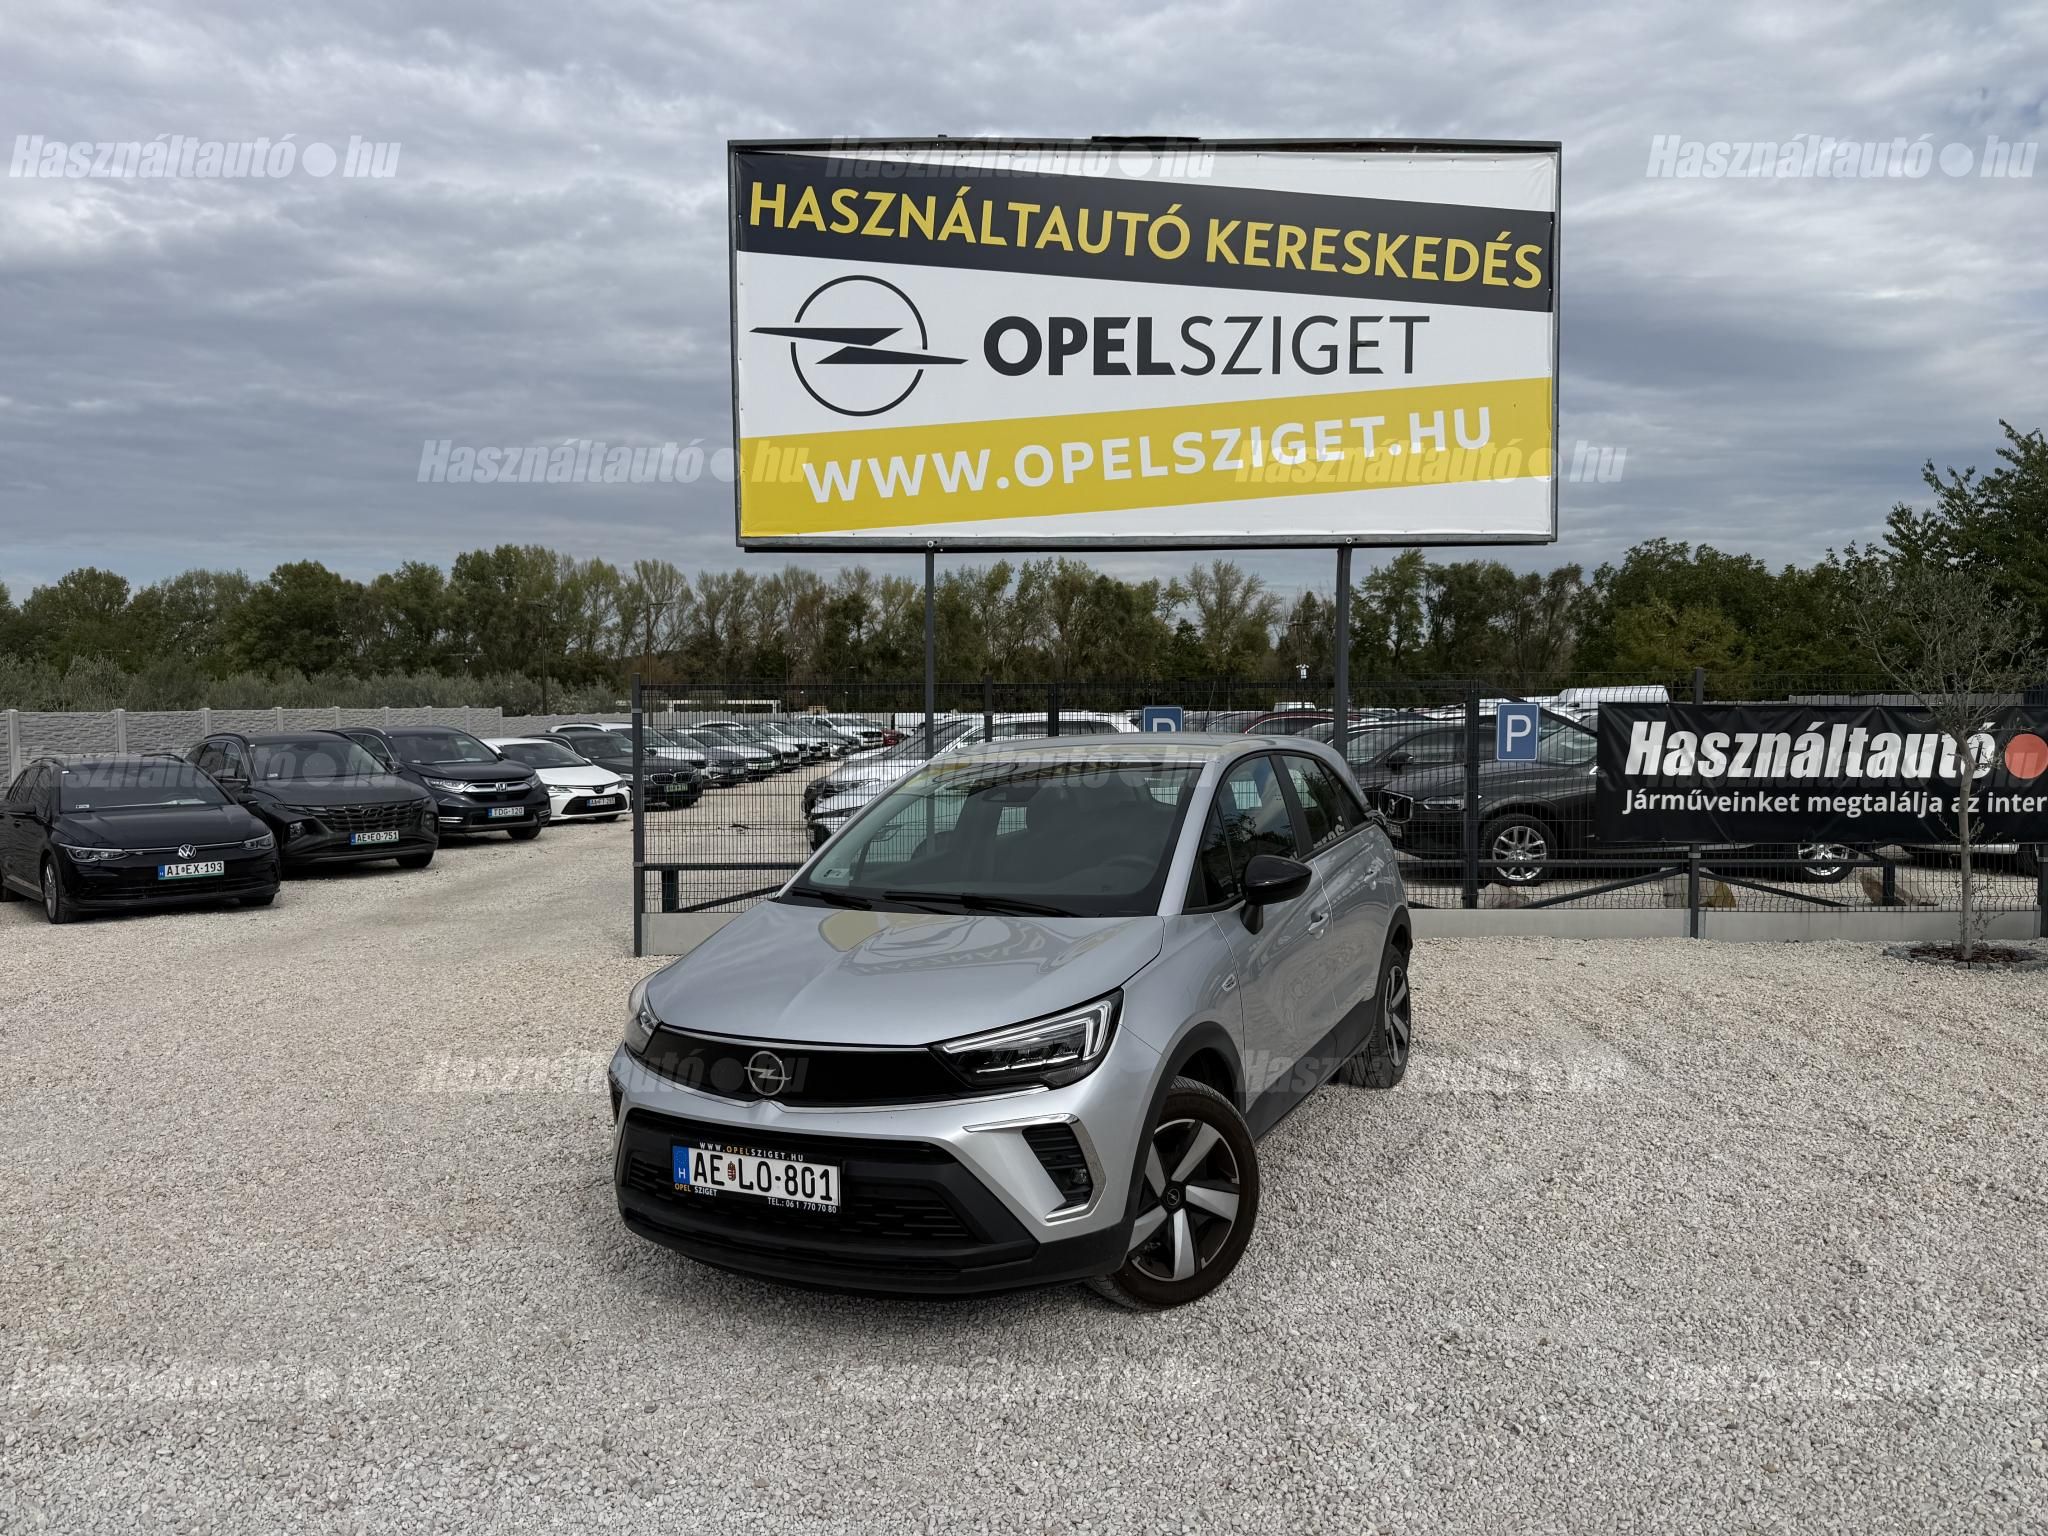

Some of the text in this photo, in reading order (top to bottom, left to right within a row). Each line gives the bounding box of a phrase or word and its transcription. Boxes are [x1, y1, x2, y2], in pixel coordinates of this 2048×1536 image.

[749, 180, 1543, 290] HASZNÁLTAUTÓ KERESKEDÉS
[983, 315, 1430, 377] OPELSZIGET
[802, 406, 1493, 504] WWW.OPELSZIGET.HU
[1506, 714, 1531, 752] P
[1624, 721, 1996, 779] Használtautó
[1622, 788, 2048, 818] Járműveinket megtalálja az inter
[166, 862, 223, 876] AI EX-193
[699, 1142, 804, 1162] WWW.OPELSZIGET.HU
[674, 1183, 718, 1197] OPEL SZIGET
[677, 1167, 686, 1179] H
[693, 1151, 833, 1202] AE LO-801
[767, 1197, 784, 1207] TEL.:
[785, 1200, 794, 1209] 06
[803, 1201, 816, 1211] 770
[817, 1203, 827, 1213] 70
[827, 1204, 837, 1214] 80
